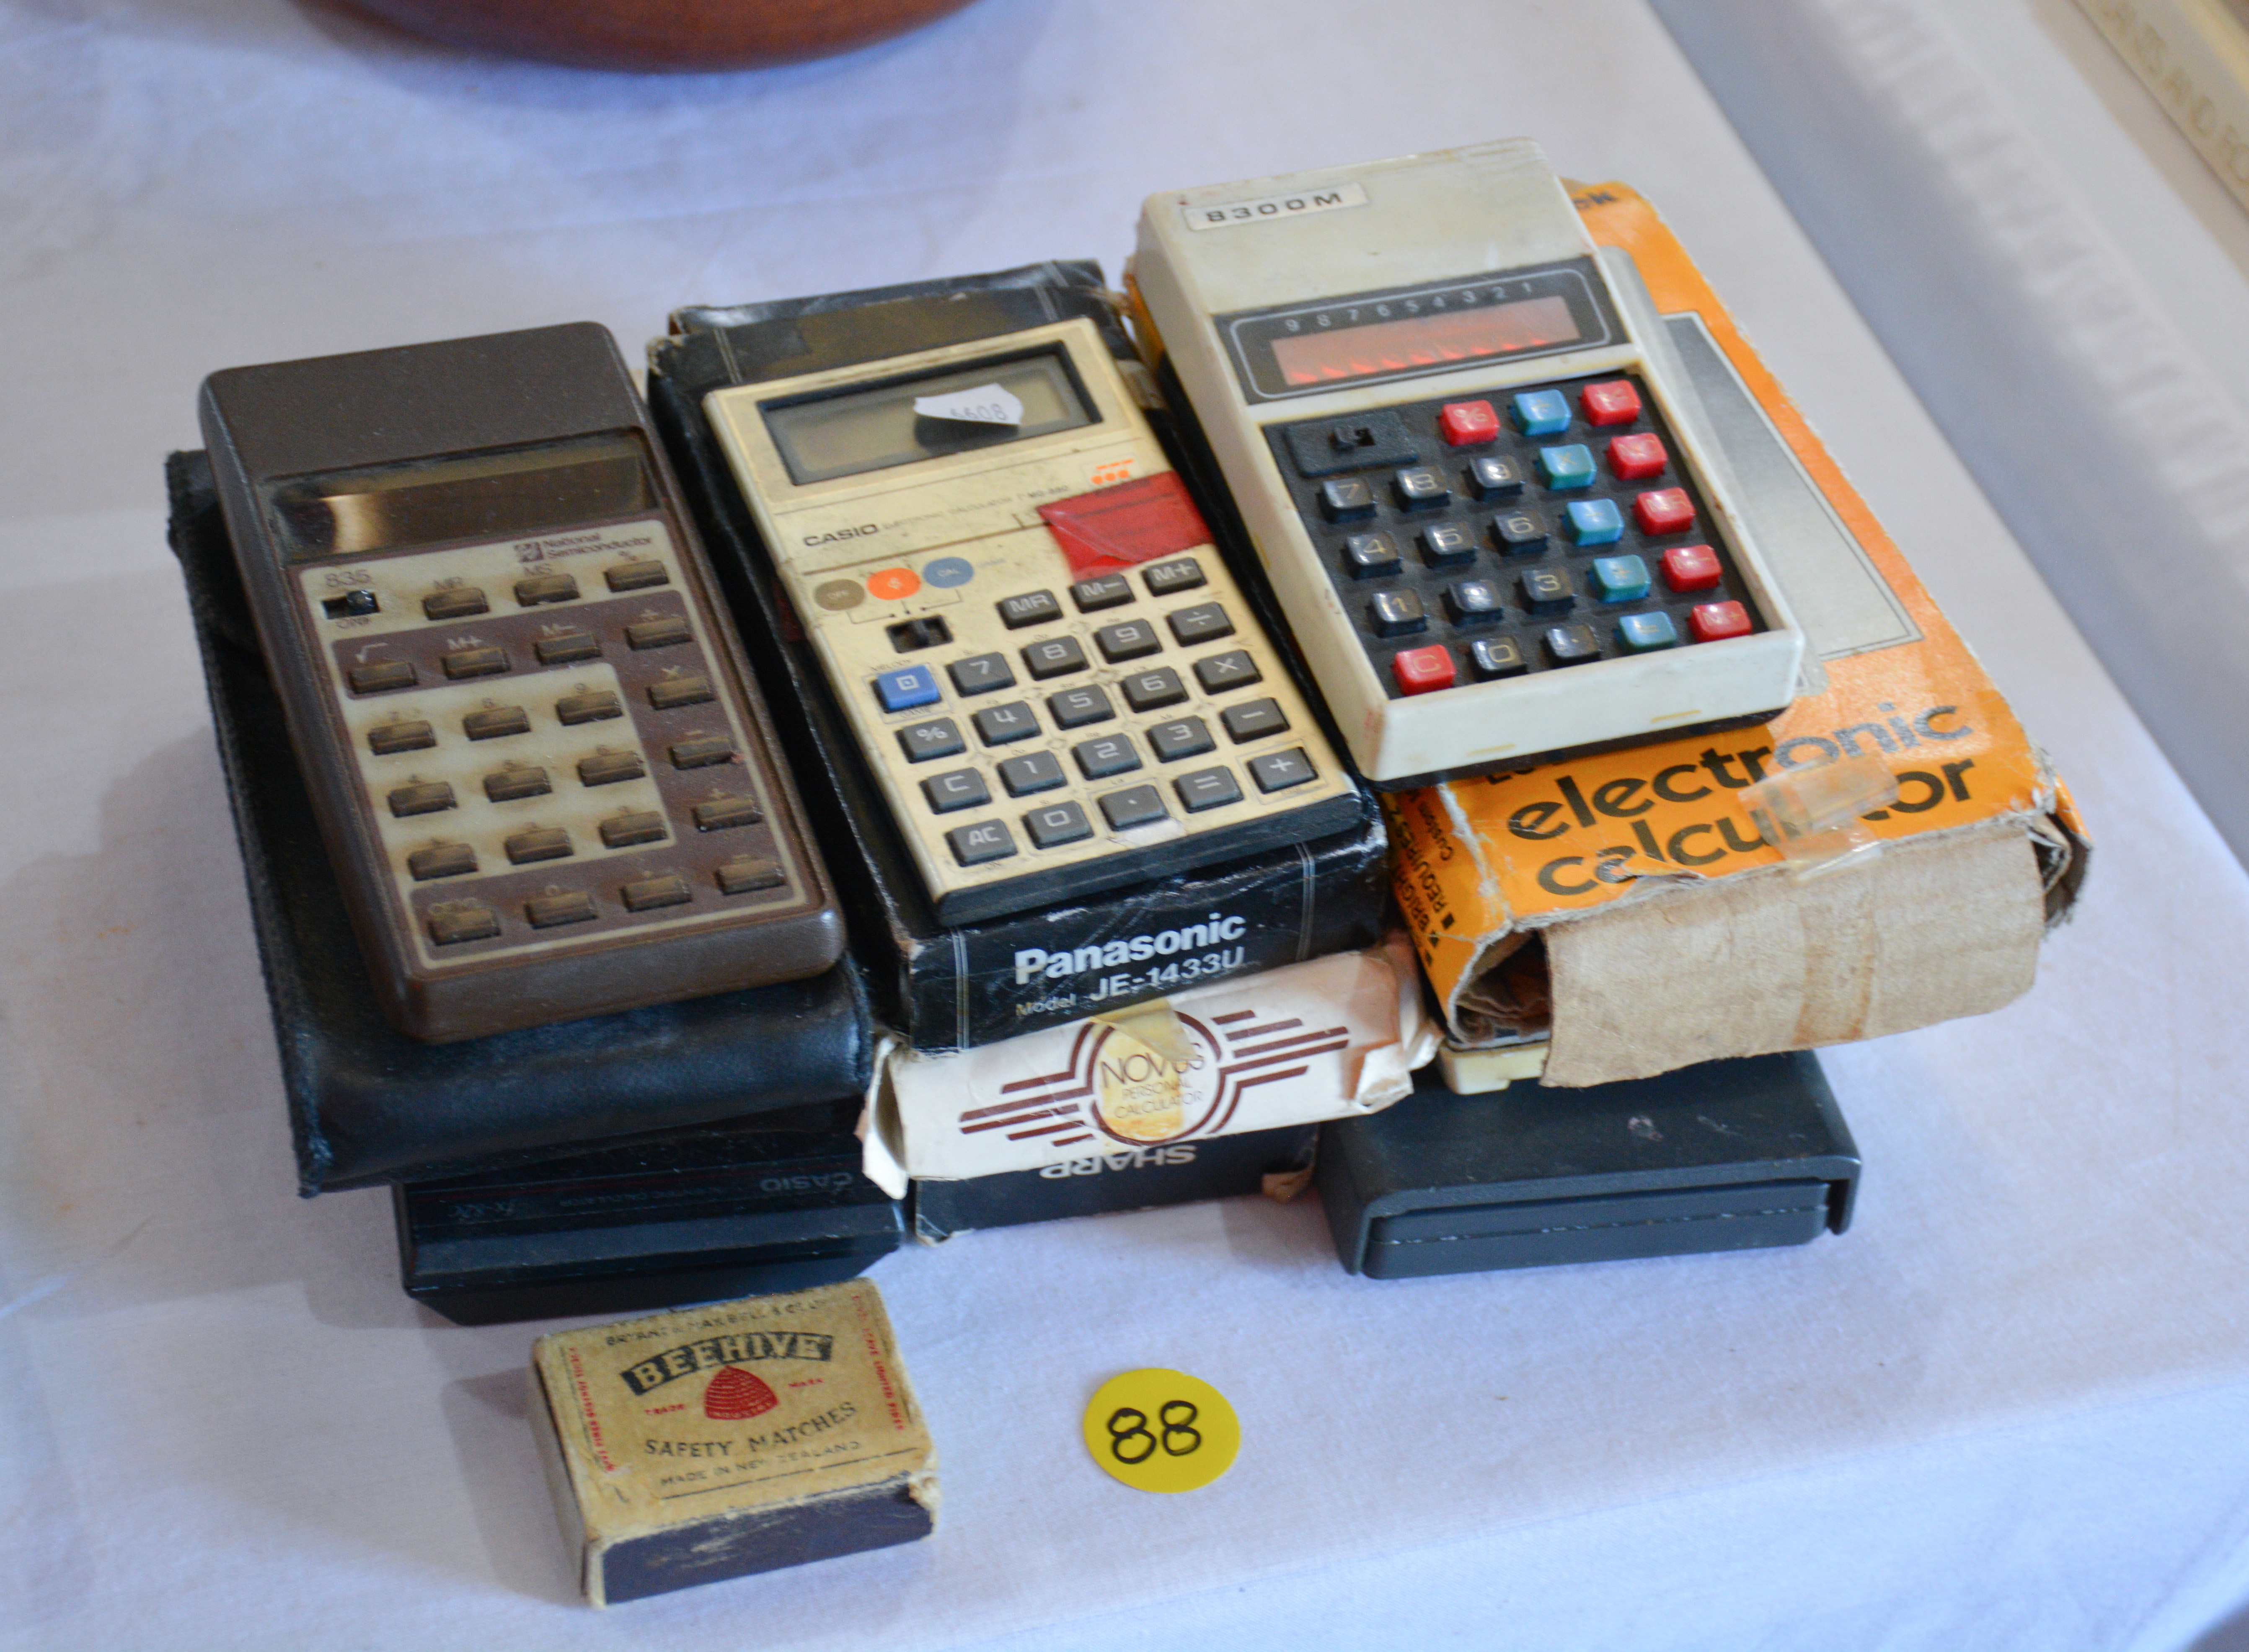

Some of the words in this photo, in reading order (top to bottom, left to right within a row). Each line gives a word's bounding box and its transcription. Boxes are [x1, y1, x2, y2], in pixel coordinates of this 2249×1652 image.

[1206, 192, 1342, 222] 8300M
[1285, 319, 1299, 332] 9
[1316, 314, 1331, 327] 8
[1347, 309, 1360, 321] 7
[1376, 304, 1391, 317] 6
[1405, 300, 1419, 313] 5
[1432, 296, 1447, 308] 4
[1463, 290, 1477, 304] 3
[1492, 286, 1506, 300] 2
[1522, 281, 1532, 293] 1
[1338, 483, 1359, 499] 7
[1413, 473, 1438, 491] 8
[1488, 463, 1512, 480] 9
[803, 523, 878, 547] CASIO
[1362, 539, 1388, 554] 4
[1437, 528, 1464, 545] 5
[1508, 517, 1535, 534] 6
[326, 570, 372, 587] 835
[1009, 594, 1050, 613] MR
[1152, 563, 1192, 581] M+
[1391, 597, 1409, 612] 1
[1534, 574, 1562, 592] 3
[968, 660, 990, 675] 7
[1042, 643, 1068, 660] 8
[1115, 626, 1141, 643] 9
[1412, 654, 1441, 673] C
[993, 709, 1019, 724] 4
[1068, 691, 1093, 709] 5
[1140, 674, 1167, 692] 6
[943, 775, 970, 793] C
[1023, 760, 1039, 775] 1
[1093, 742, 1120, 759] 2
[1168, 724, 1194, 742] 3
[1507, 701, 1974, 840] electronic
[968, 826, 1000, 846] AC
[1043, 809, 1071, 828] 0
[1014, 912, 1246, 985] Panasonic
[1089, 946, 1245, 1001] JE-1433U
[1114, 1090, 1204, 1119] CALCULATOR
[1122, 1078, 1192, 1101] PERSONAL
[759, 1172, 854, 1193] CASIO
[1039, 1145, 1197, 1179] SHARP
[631, 1331, 825, 1391] BEEHIVE
[644, 1439, 732, 1459] SAFETY
[747, 1401, 857, 1453] MATCHES
[1106, 1400, 1201, 1465] 88
[660, 1470, 708, 1486] MADE
[713, 1464, 732, 1475] IN
[778, 1441, 860, 1463] ZEALAND
